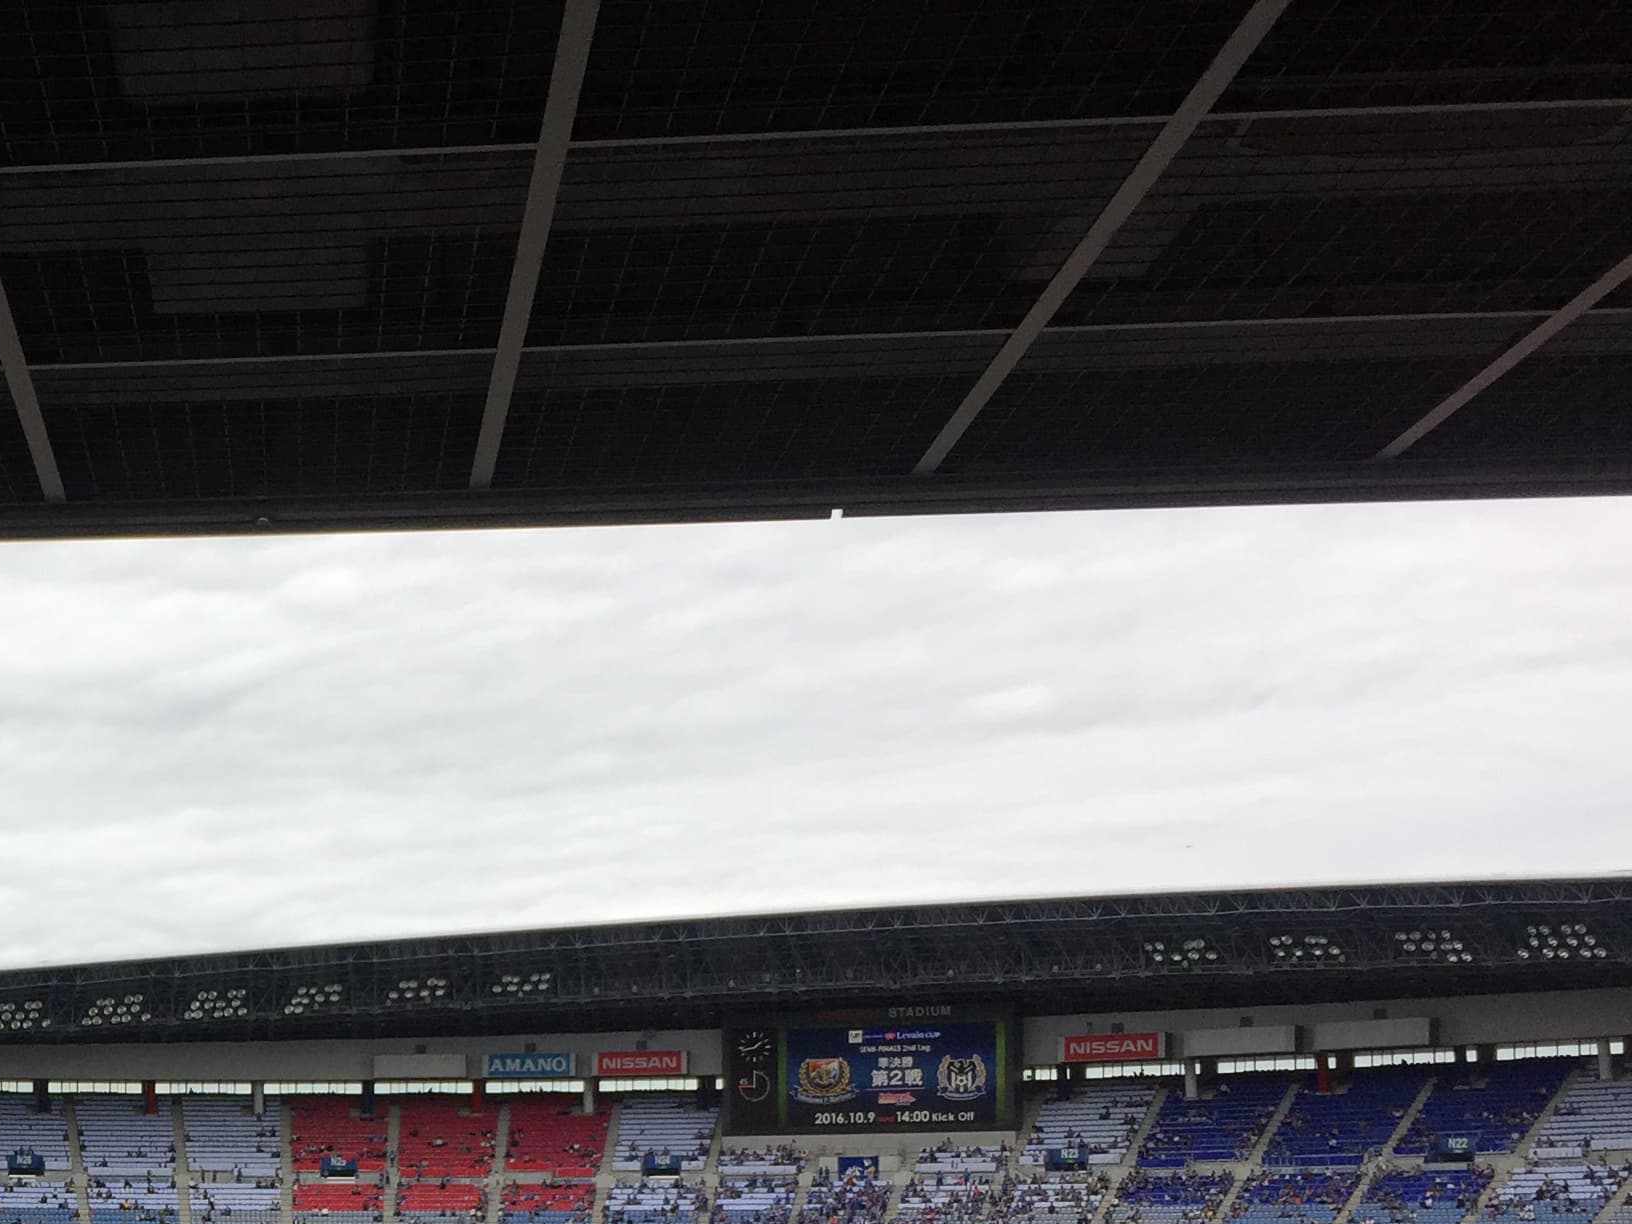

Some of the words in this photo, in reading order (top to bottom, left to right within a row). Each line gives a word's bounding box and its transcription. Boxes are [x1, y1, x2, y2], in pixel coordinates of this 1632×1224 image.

[888, 1006, 952, 1018] STADIUM
[1068, 1038, 1155, 1056] NISSAN
[488, 1056, 568, 1074] AMANO
[601, 1055, 679, 1071] NISSAN
[871, 1069, 924, 1087] 第2戦
[814, 1112, 876, 1125] 2016.10.9
[896, 1111, 930, 1123] 14:00
[932, 1112, 955, 1122] Kick
[958, 1111, 975, 1121] Off
[1448, 1137, 1468, 1149] N22
